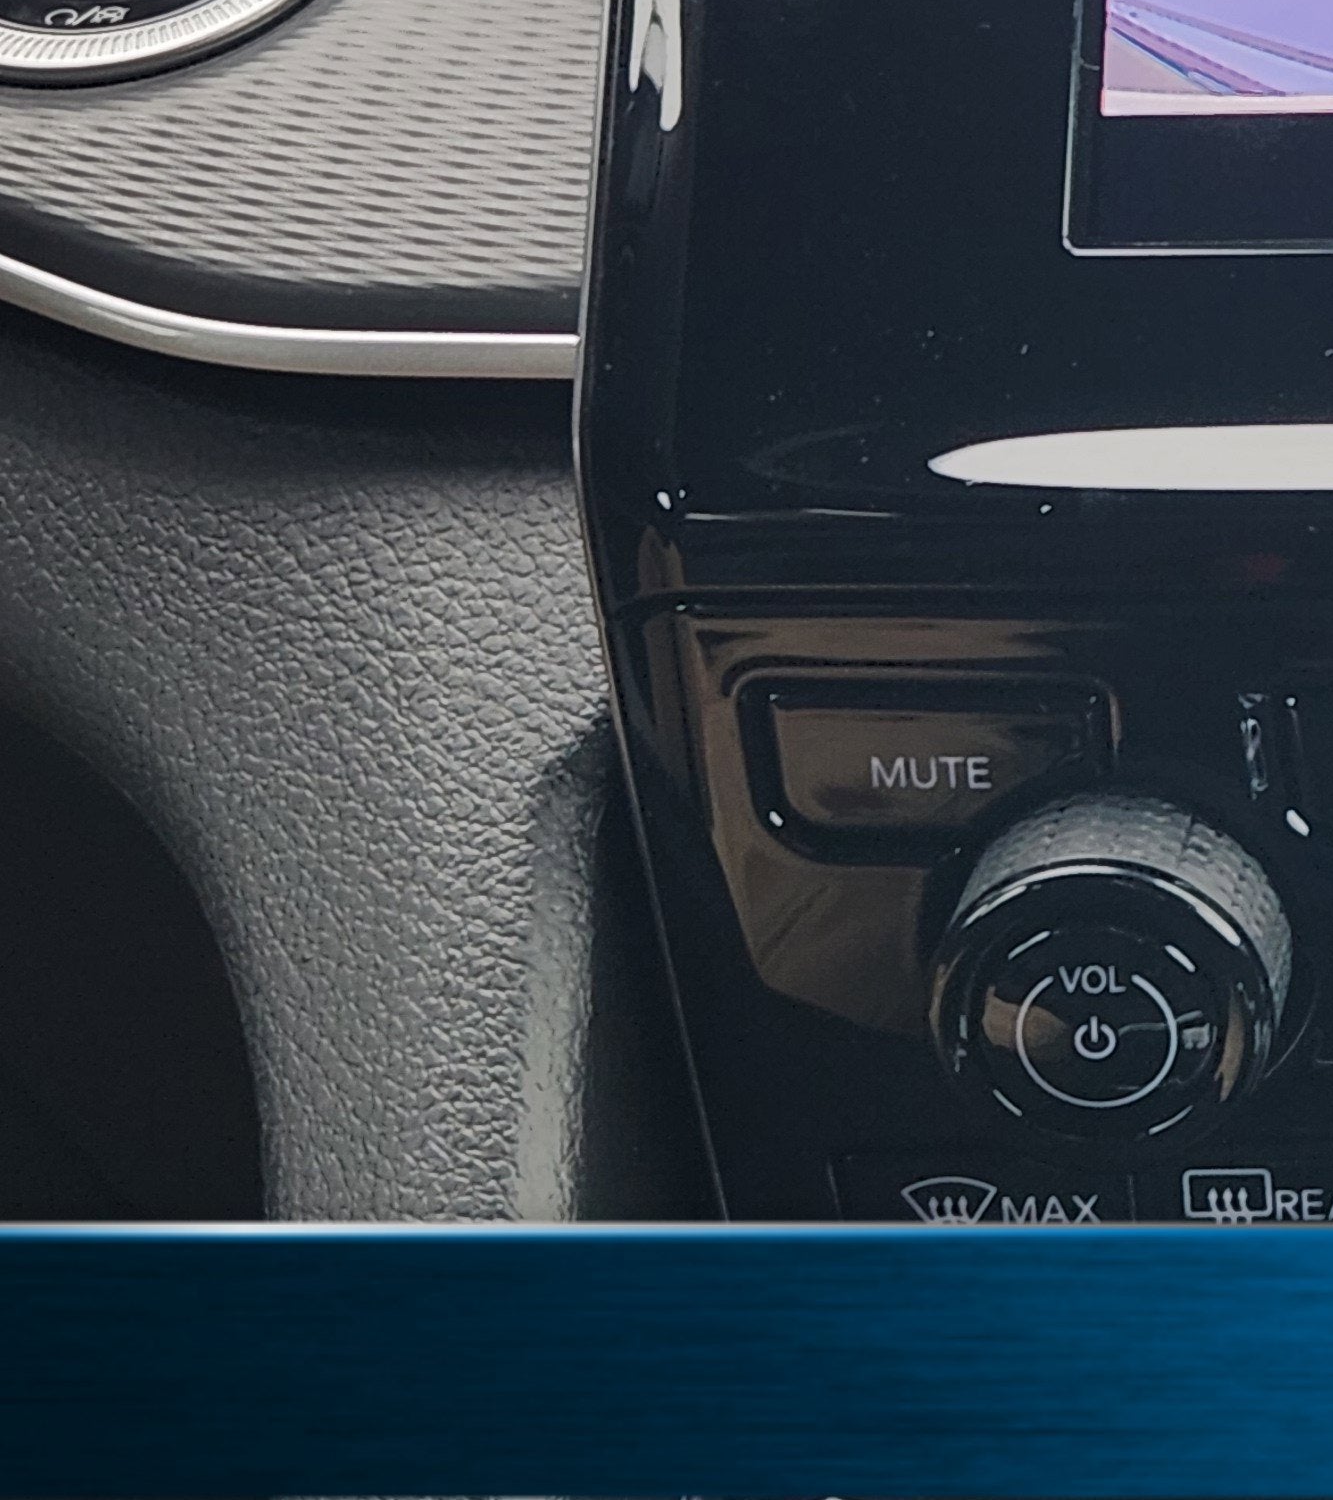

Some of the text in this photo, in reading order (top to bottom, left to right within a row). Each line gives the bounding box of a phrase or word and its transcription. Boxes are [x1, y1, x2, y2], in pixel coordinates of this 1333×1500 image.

[870, 756, 992, 790] MUTE
[1058, 966, 1127, 994] VOL
[1001, 1194, 1100, 1224] MAX
